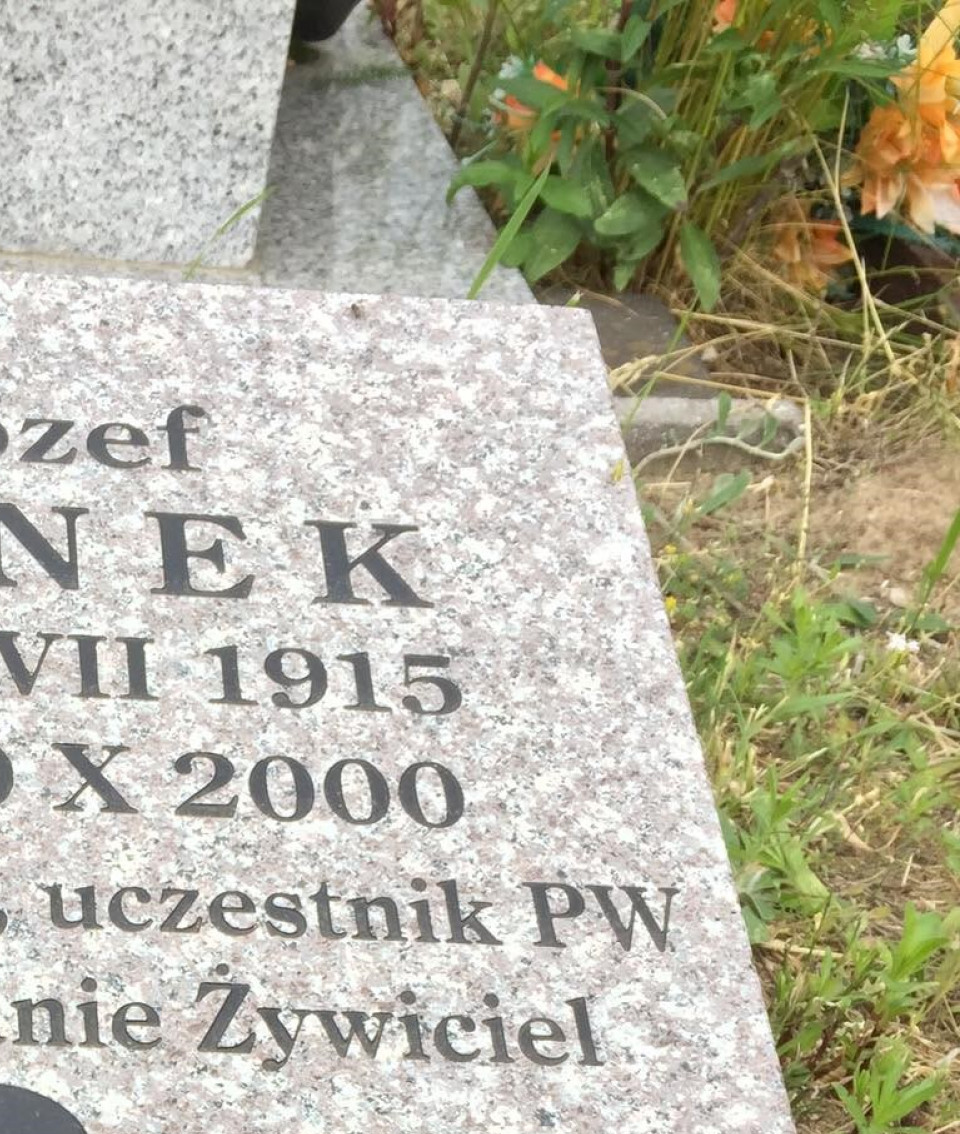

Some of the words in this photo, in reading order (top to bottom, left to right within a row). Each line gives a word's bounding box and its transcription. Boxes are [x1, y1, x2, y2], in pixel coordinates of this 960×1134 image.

[206, 645, 463, 717] 1915
[52, 743, 138, 815] X
[173, 752, 465, 829] 2000
[41, 877, 503, 946] uczestnik
[523, 881, 680, 952] PW
[196, 963, 605, 1072] Żywiciel
